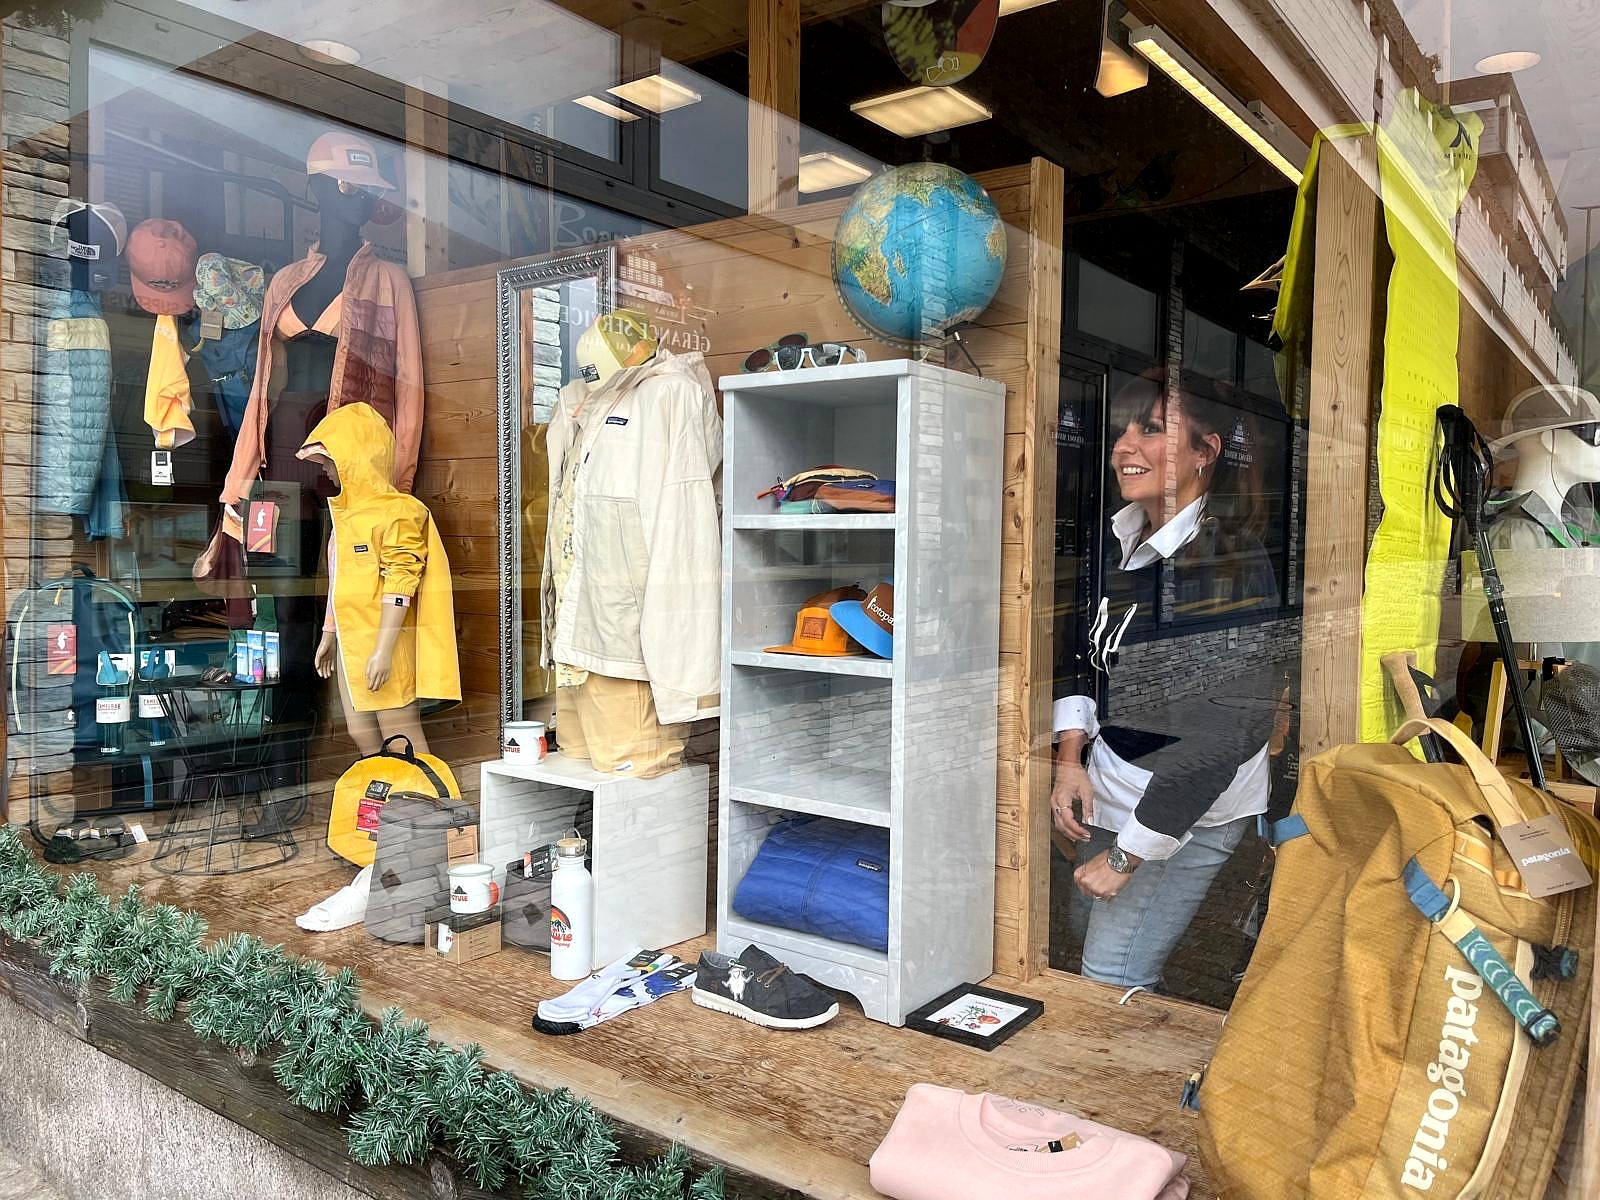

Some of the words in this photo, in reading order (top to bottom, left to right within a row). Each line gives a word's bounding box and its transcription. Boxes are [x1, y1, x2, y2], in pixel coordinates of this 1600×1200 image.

[534, 115, 544, 174] BURON
[871, 603, 895, 626] cotopa
[1522, 847, 1571, 867] patagonia
[1400, 964, 1484, 1191] patagonia
